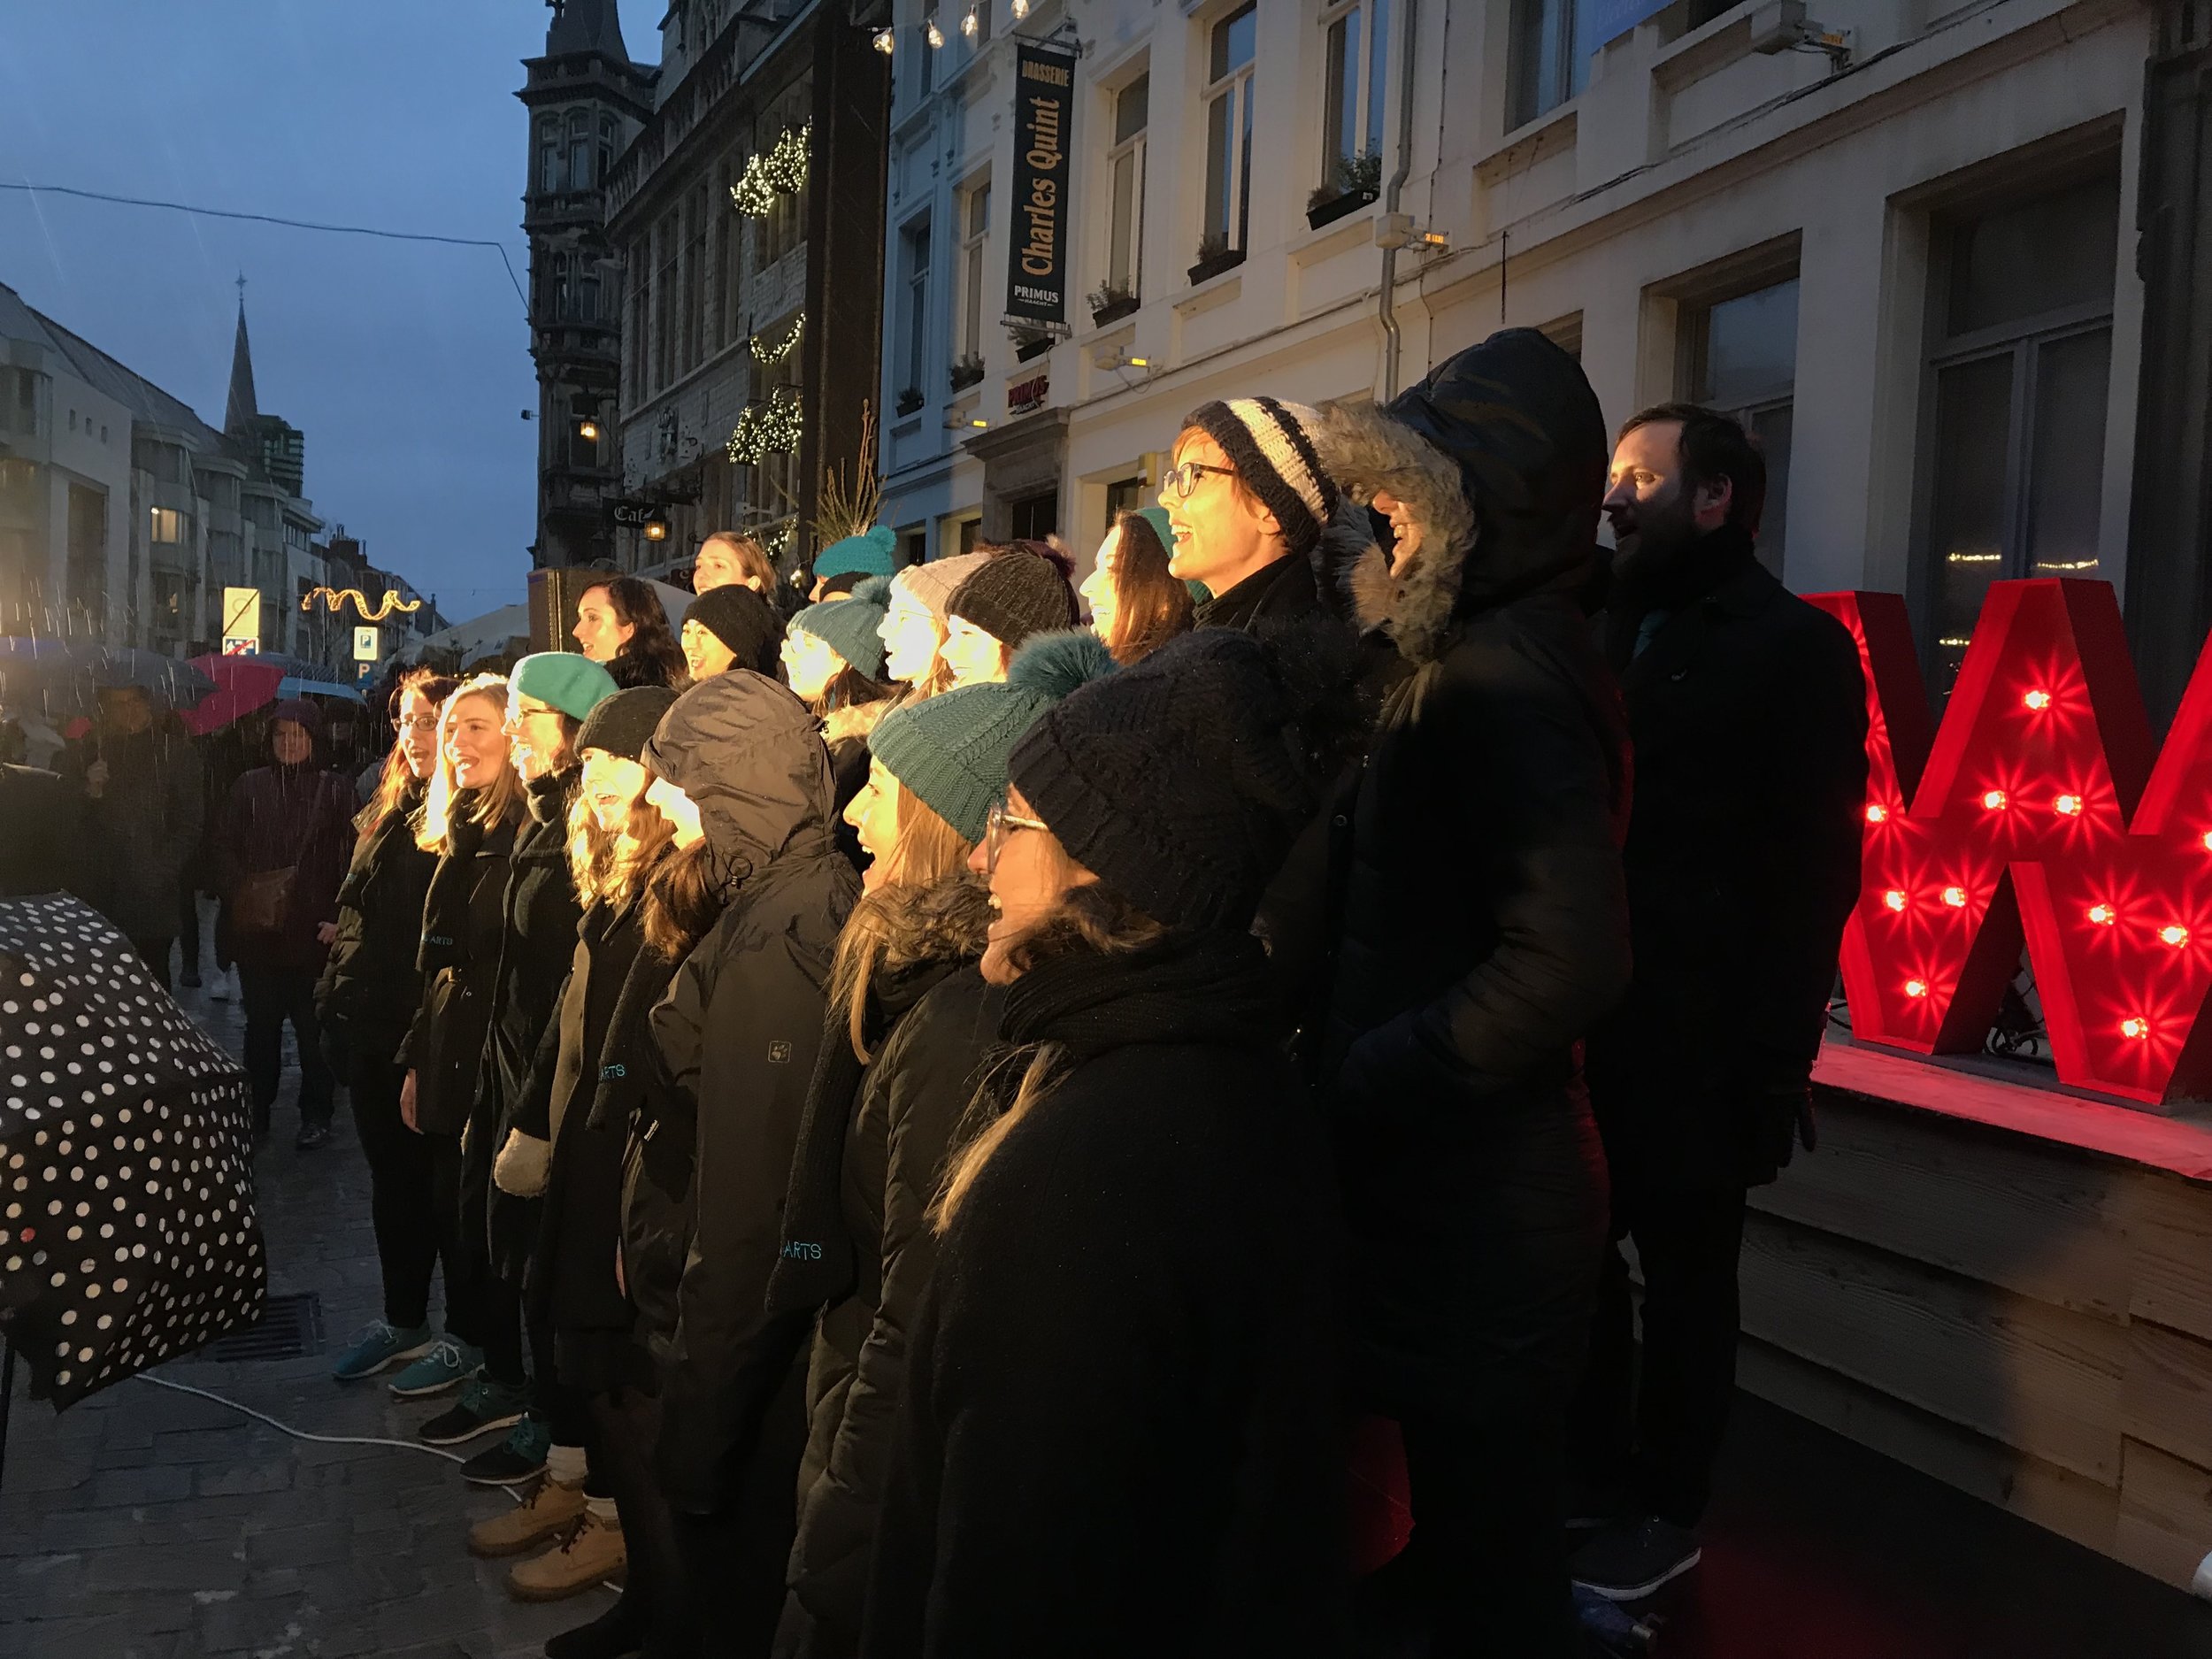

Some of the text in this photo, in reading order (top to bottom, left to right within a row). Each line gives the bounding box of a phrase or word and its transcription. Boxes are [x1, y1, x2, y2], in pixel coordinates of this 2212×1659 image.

[1021, 59, 1069, 87] BRASSERIE
[1021, 96, 1063, 276] Charles Quint
[1014, 285, 1059, 303] PRIMUS
[358, 663, 371, 680] P
[429, 935, 453, 946] ARTS
[783, 1240, 822, 1261] ARTS
